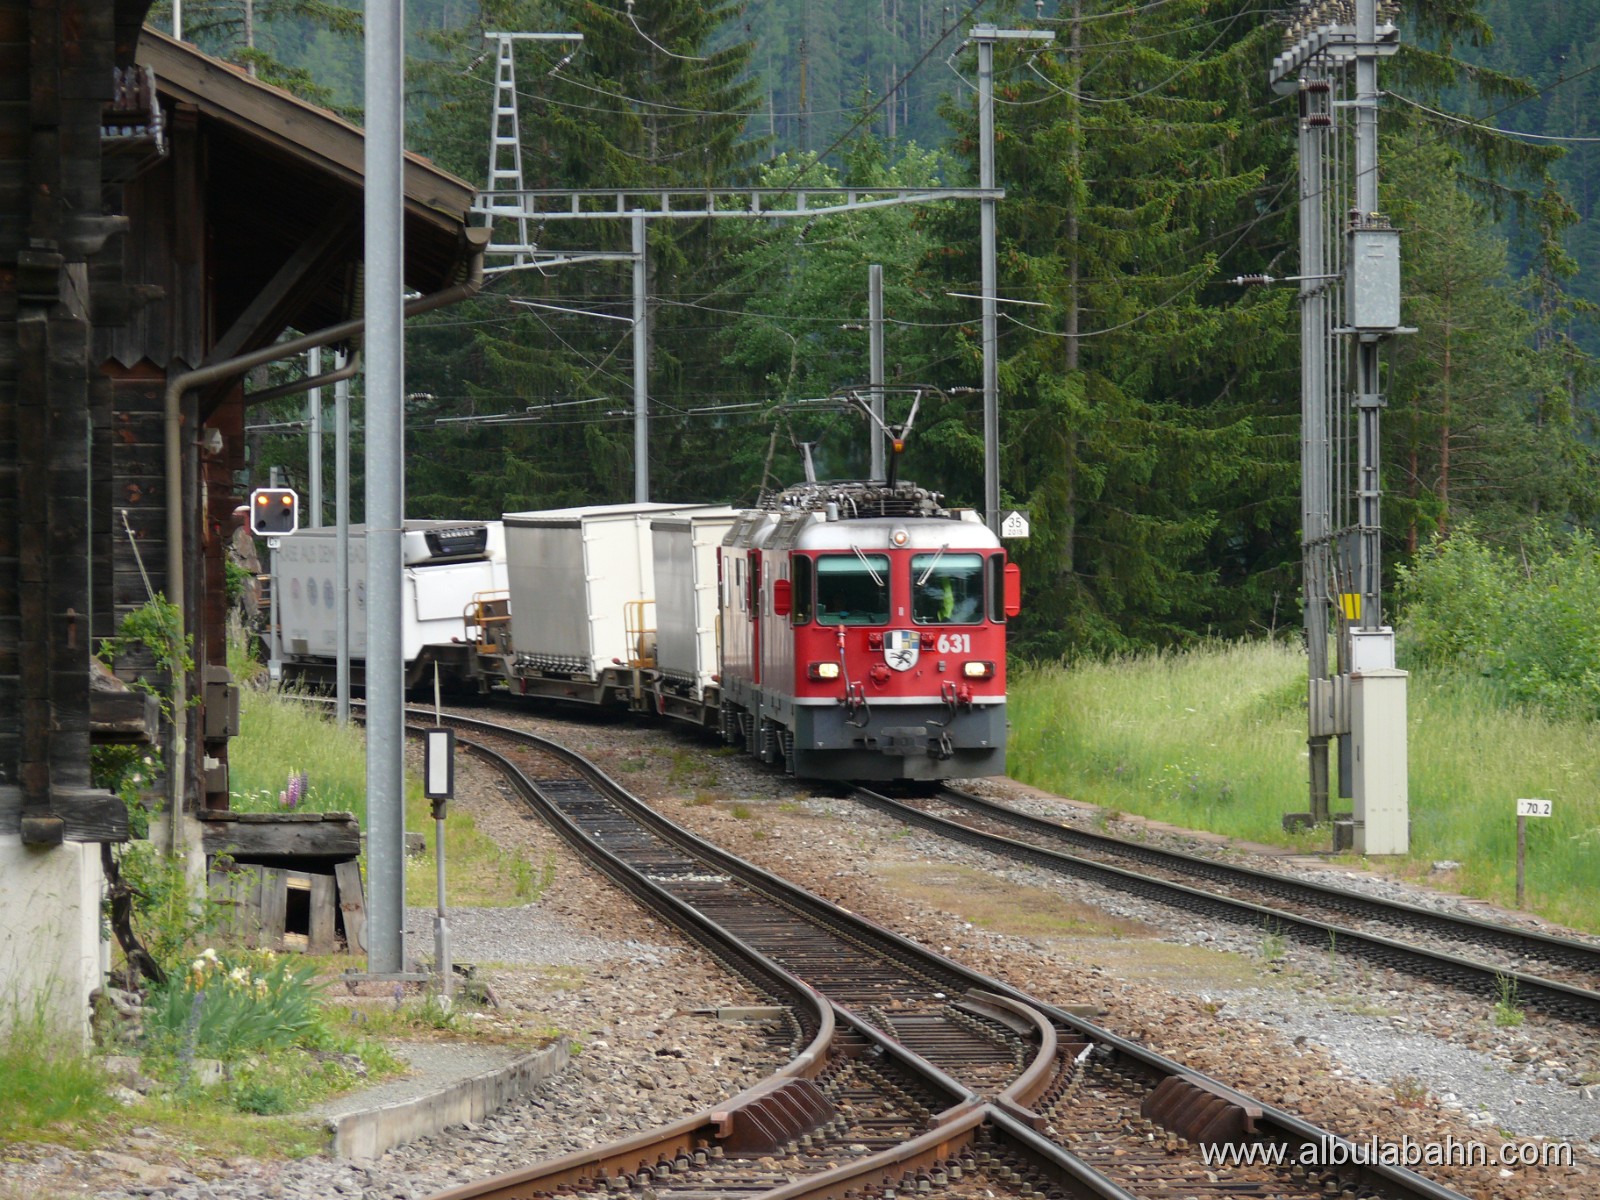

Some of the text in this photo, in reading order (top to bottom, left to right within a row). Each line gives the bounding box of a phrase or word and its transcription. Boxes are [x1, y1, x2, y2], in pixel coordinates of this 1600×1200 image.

[1008, 517, 1022, 528] 35
[440, 530, 475, 538] CARRIER
[937, 633, 971, 654] 631
[1527, 802, 1550, 815] 70.2
